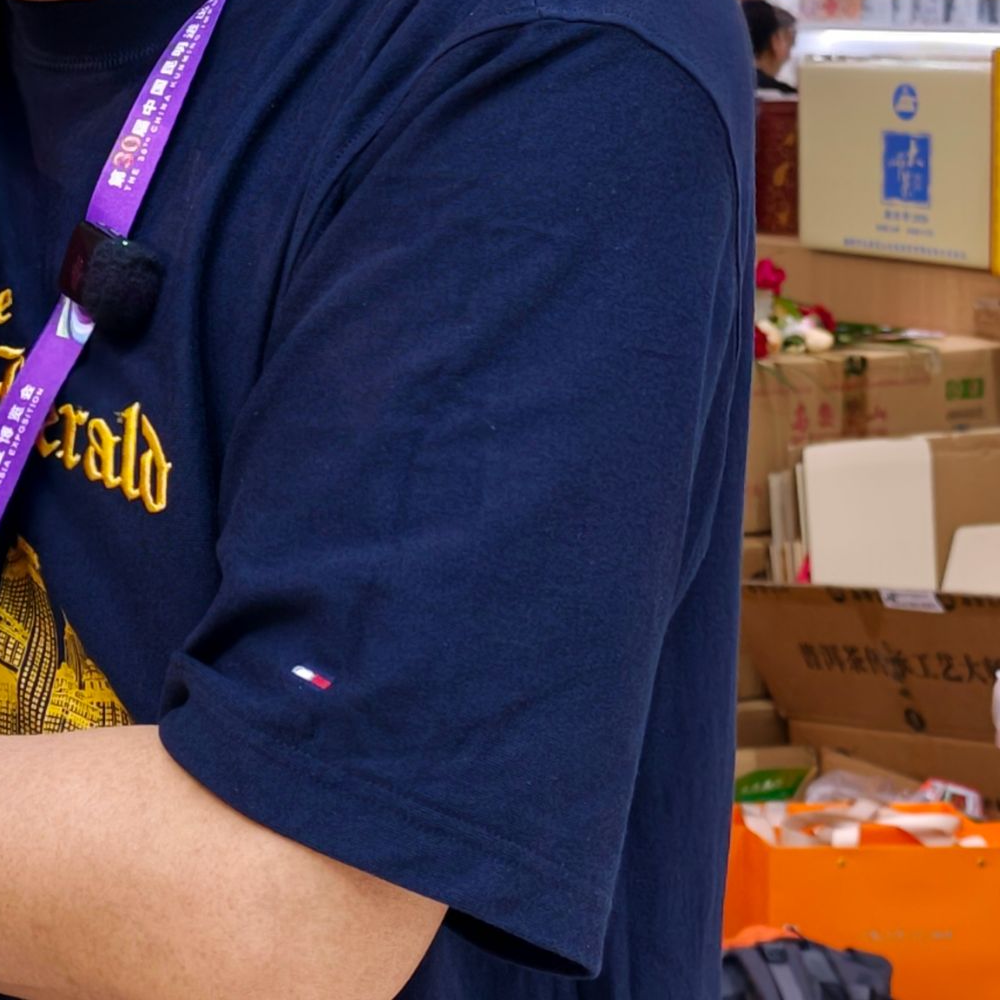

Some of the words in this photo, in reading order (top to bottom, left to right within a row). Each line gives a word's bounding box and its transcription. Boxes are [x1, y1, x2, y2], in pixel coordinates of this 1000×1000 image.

[123, 165, 141, 192] THE
[150, 94, 173, 134] CHINA
[169, 33, 201, 88] KUNMING
[8, 386, 45, 457] EXPOSITION
